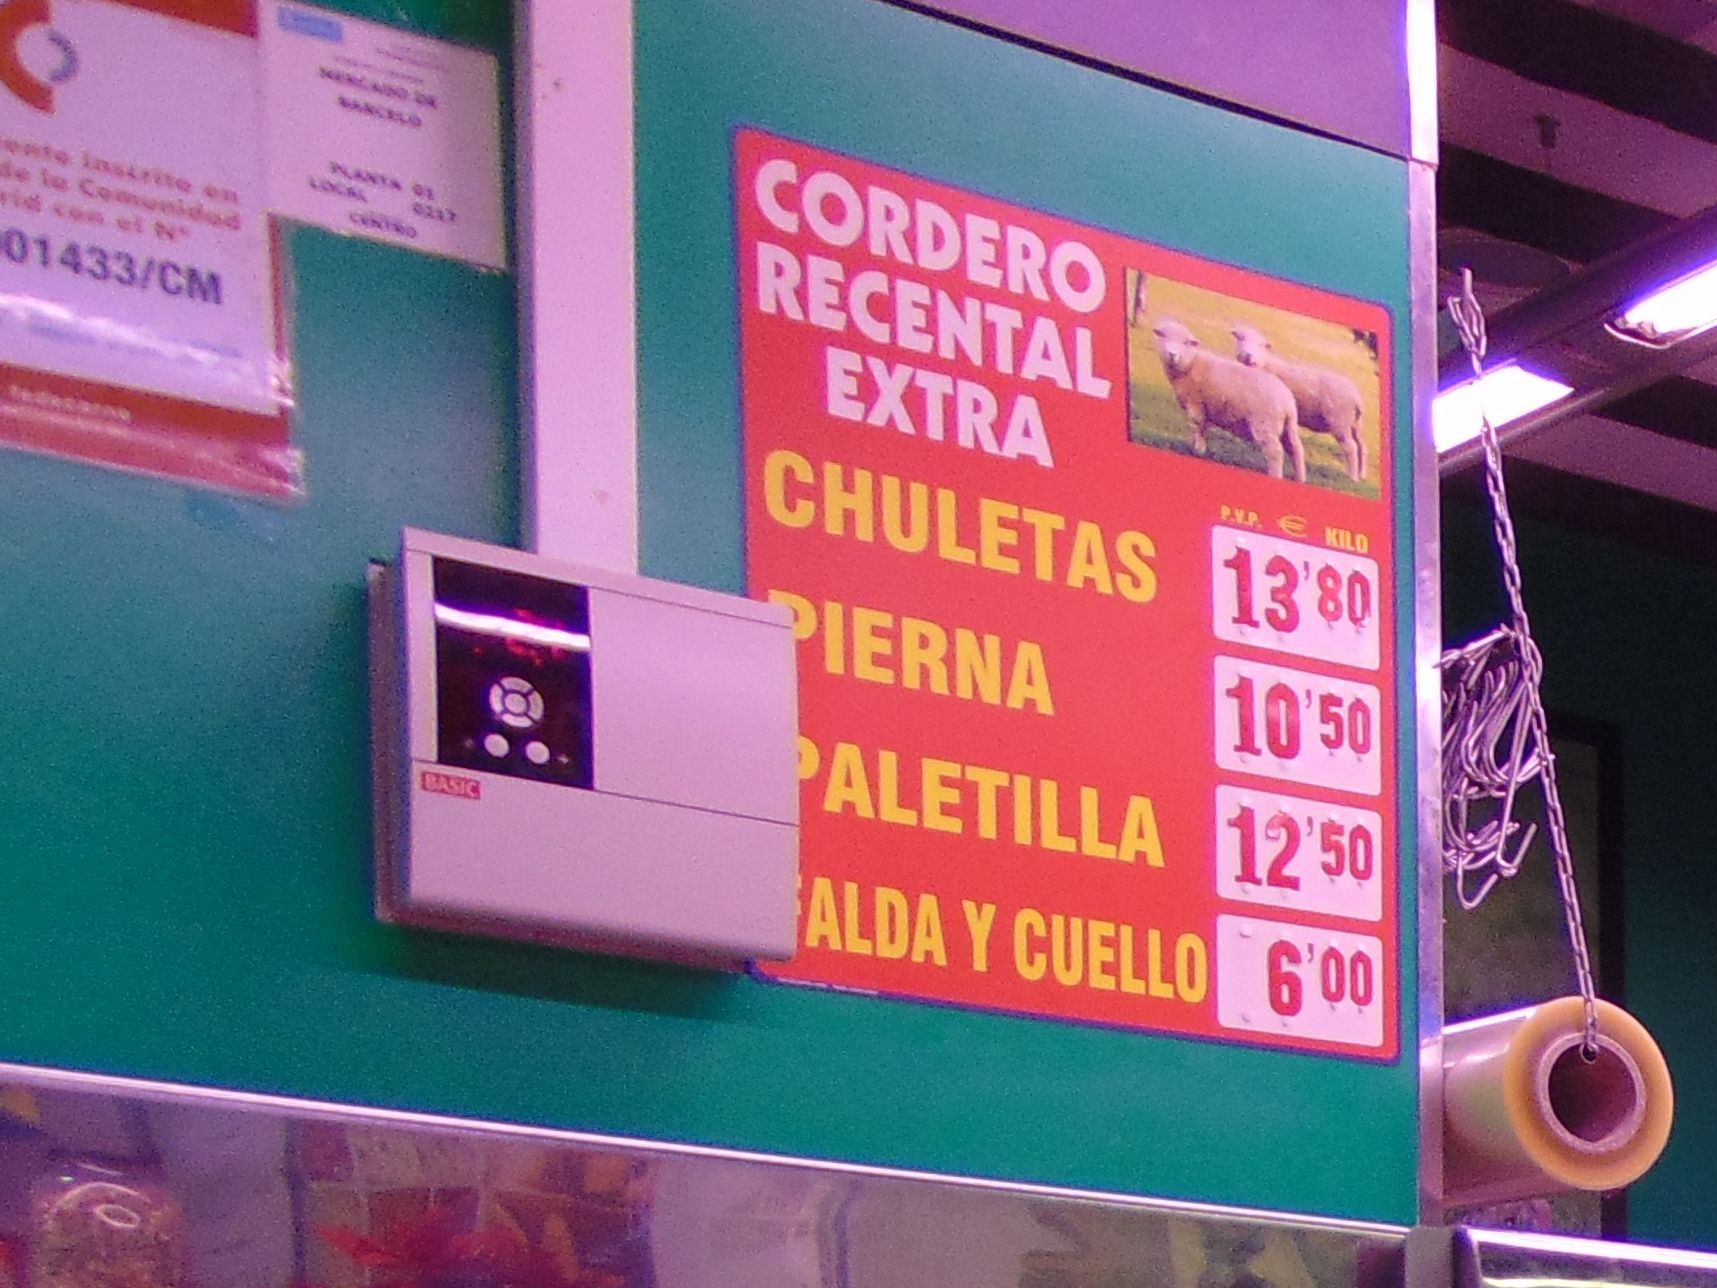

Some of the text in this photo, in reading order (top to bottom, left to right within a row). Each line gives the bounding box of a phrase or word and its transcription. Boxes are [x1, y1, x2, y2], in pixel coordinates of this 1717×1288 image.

[0, 137, 71, 166] ento
[0, 226, 223, 305] 01433/CM
[754, 158, 1108, 314] CORDERO
[755, 242, 1113, 399] RECENTAL
[825, 346, 1055, 469] EXTRA
[763, 448, 1159, 605] CHULETAS
[1221, 504, 1263, 530] P.V.P.
[1325, 526, 1369, 555] KILO
[424, 773, 481, 799] BASIC
[797, 875, 1209, 1004] ALDA Y CUELLO
